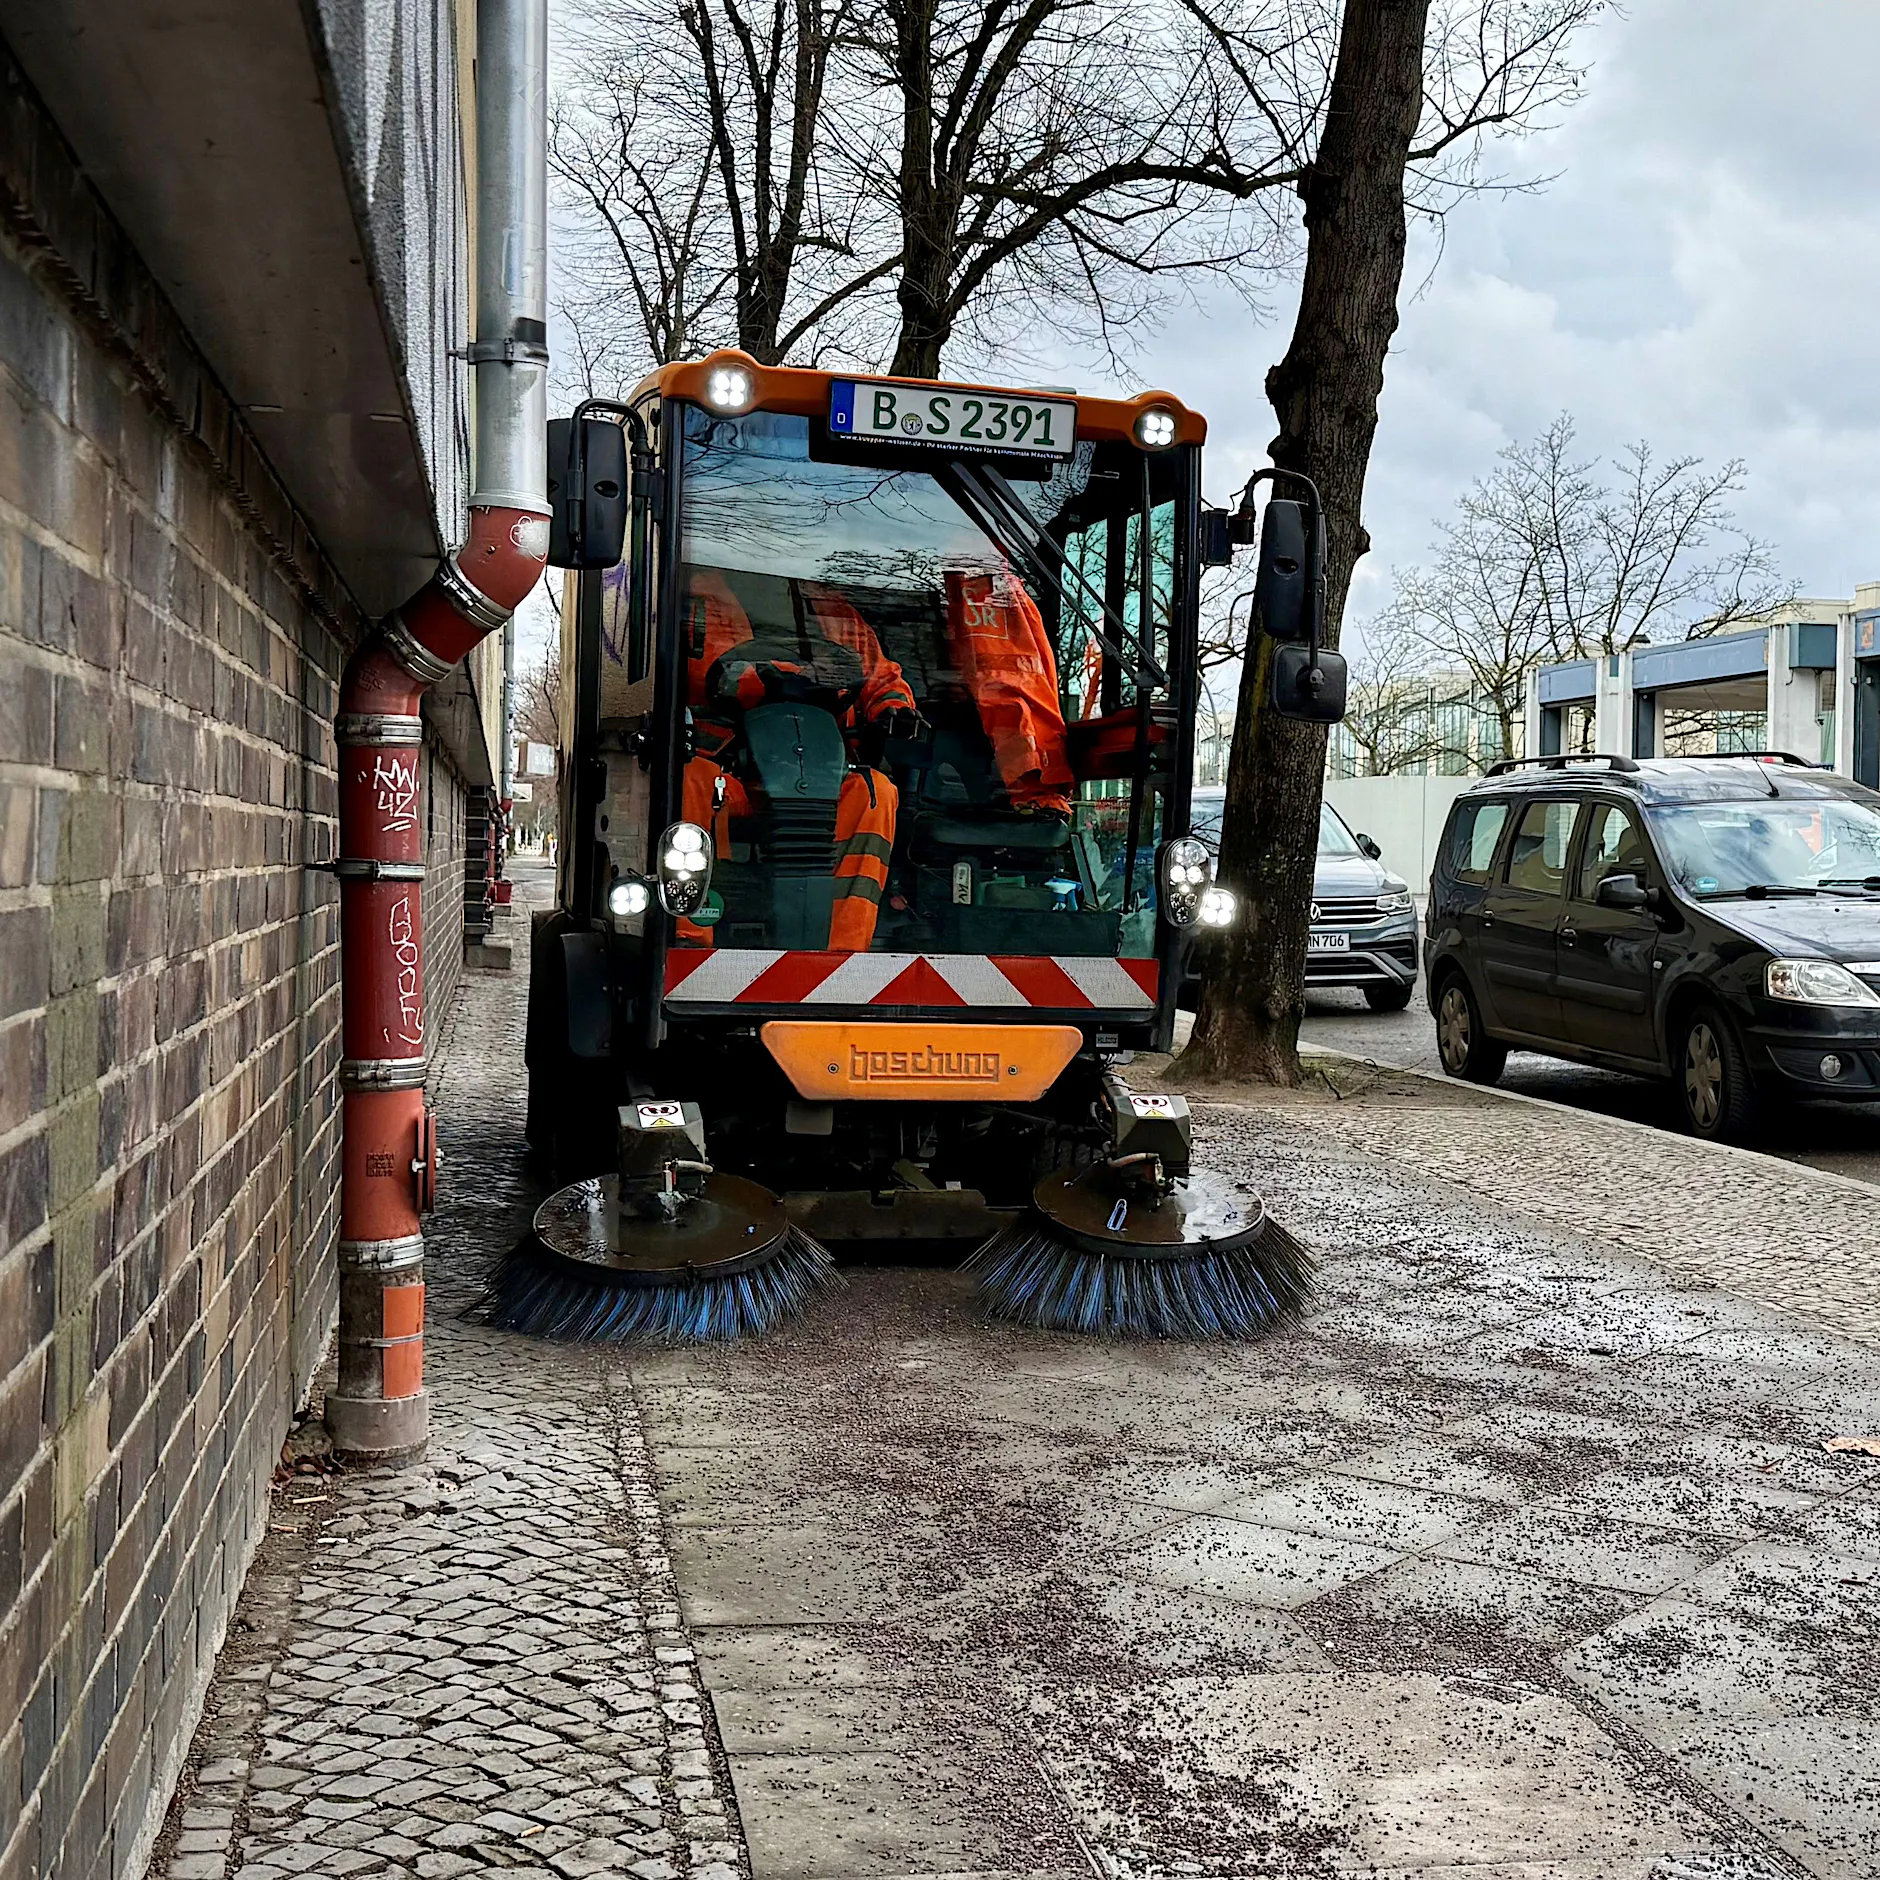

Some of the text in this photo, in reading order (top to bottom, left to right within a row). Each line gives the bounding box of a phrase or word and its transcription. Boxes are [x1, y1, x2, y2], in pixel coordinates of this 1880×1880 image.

[872, 391, 1055, 446] B S 2391
[1322, 935, 1344, 947] 706
[849, 1043, 1000, 1084] boschung
